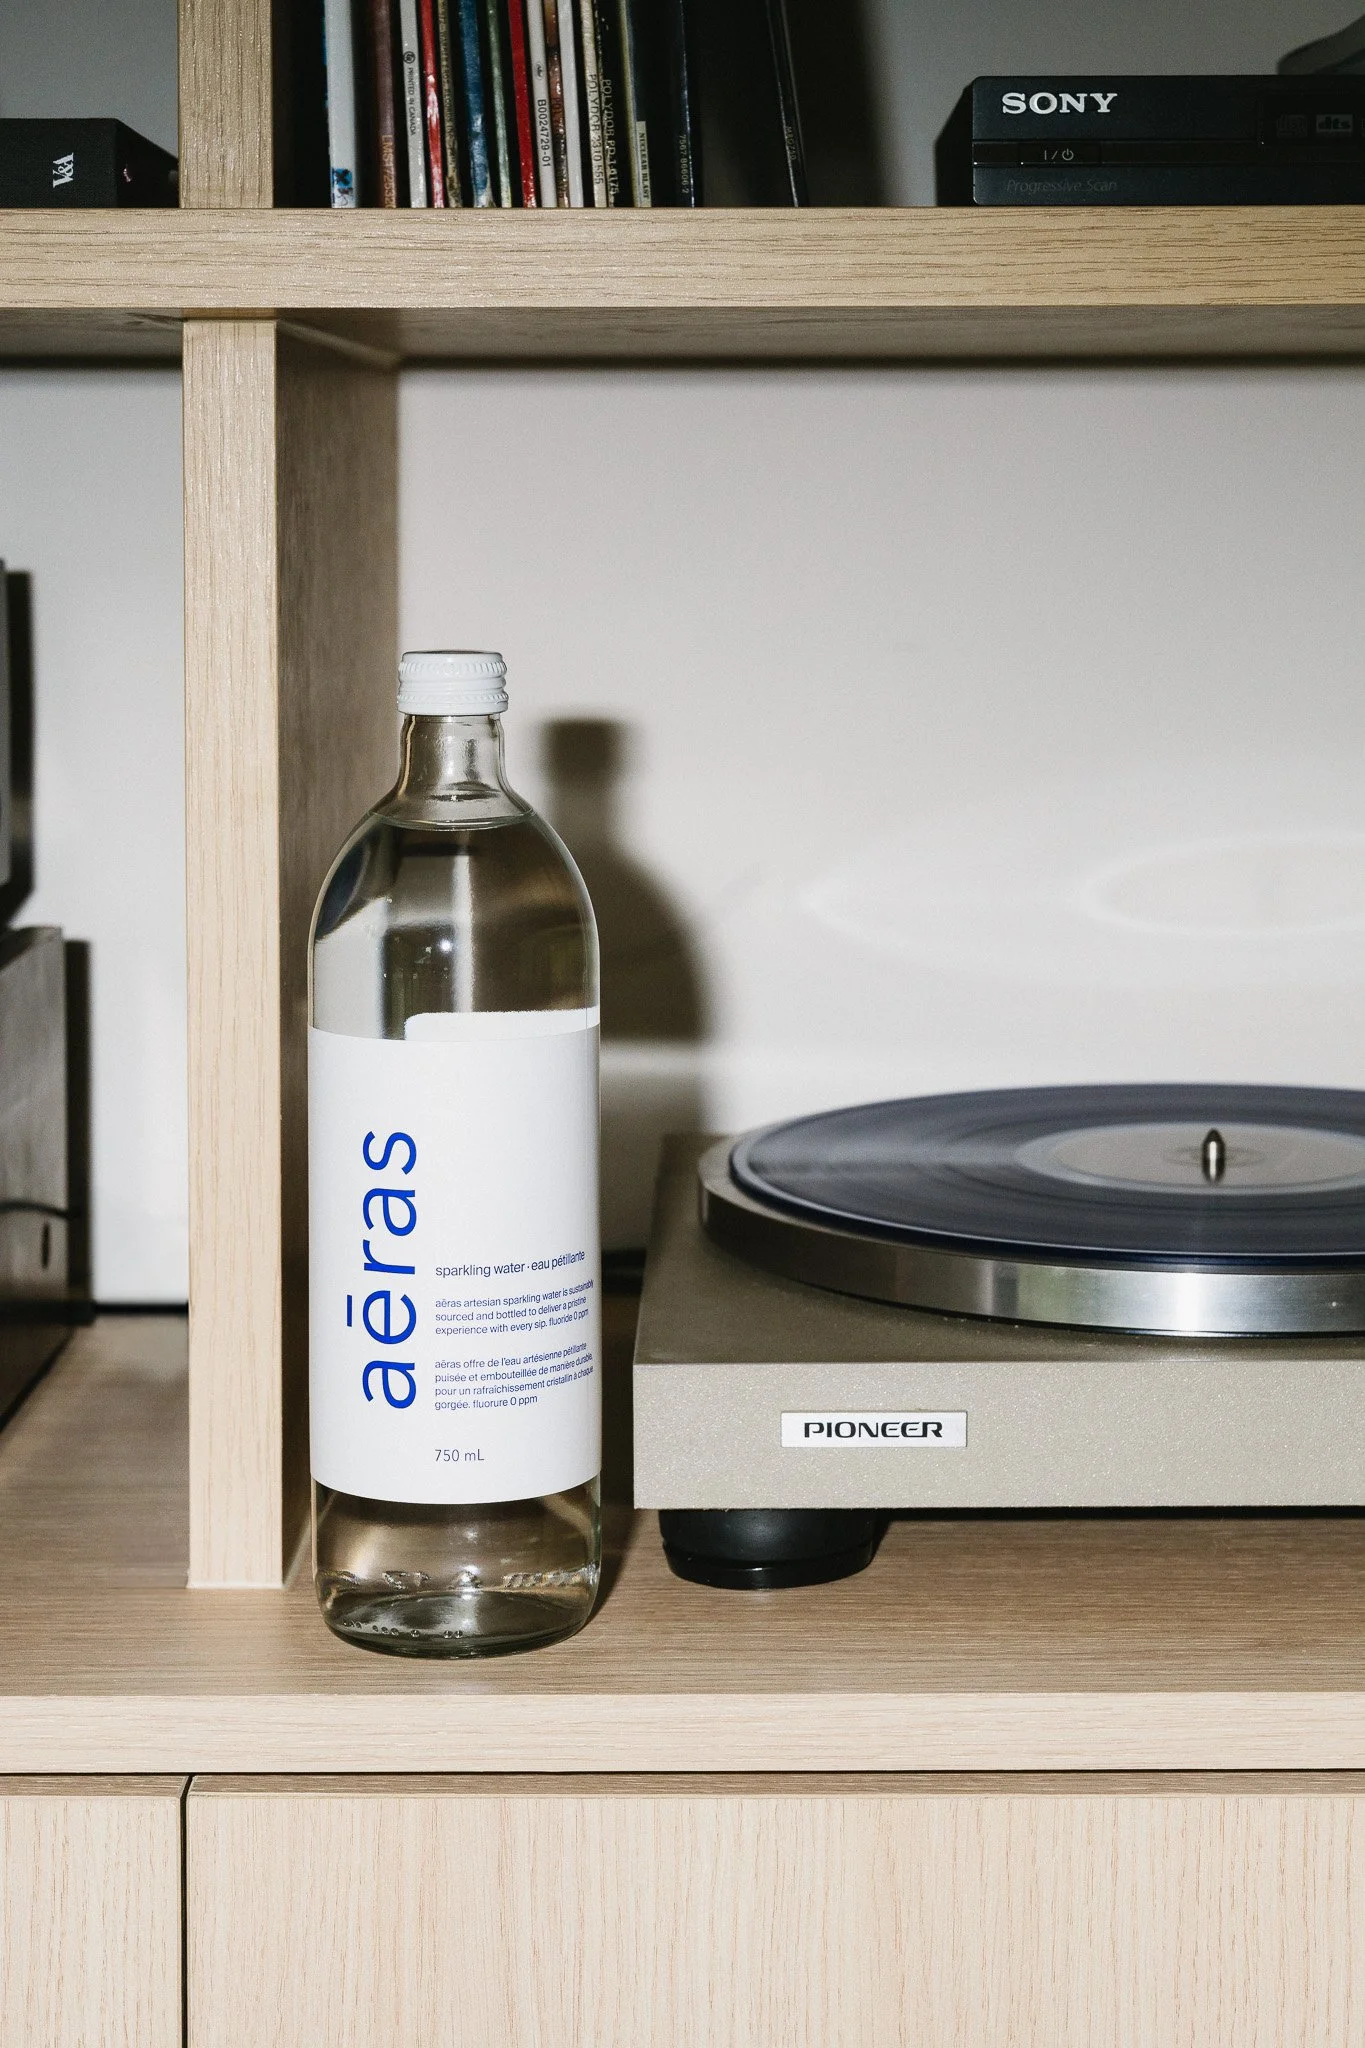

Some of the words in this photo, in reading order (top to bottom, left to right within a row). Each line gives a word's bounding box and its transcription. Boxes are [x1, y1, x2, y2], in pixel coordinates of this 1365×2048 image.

[406, 67, 415, 96] PRINTED
[409, 97, 415, 105] IN
[588, 74, 602, 132] POLYDOR
[602, 79, 615, 136] POLYDOR
[1001, 92, 1118, 115] SONY
[408, 106, 417, 136] CANADA
[537, 99, 551, 168] B0024729-01
[638, 132, 648, 171] NUCLEAR
[52, 152, 75, 189] V&A
[641, 173, 650, 200] BLAST
[1006, 178, 1083, 193] Progressive
[1086, 178, 1118, 192] Scan
[347, 1131, 417, 1410] aēras
[435, 1264, 491, 1278] sparkling
[493, 1262, 526, 1275] water
[531, 1260, 550, 1271] eau
[551, 1251, 585, 1270] pétillante
[435, 1312, 474, 1321] sourced
[476, 1311, 494, 1321] and
[496, 1308, 527, 1319] bottled
[528, 1307, 537, 1316] to
[538, 1304, 562, 1315] deliver
[562, 1302, 567, 1310] a
[567, 1296, 587, 1310] pristine
[463, 1298, 501, 1307] artesian
[503, 1294, 541, 1306] sparkling
[542, 1290, 561, 1300] water
[562, 1288, 568, 1297] is
[435, 1326, 488, 1336] experience
[489, 1323, 509, 1333] with
[510, 1322, 533, 1332] every
[534, 1319, 548, 1330] sip.
[549, 1313, 573, 1326] fluoride
[573, 1310, 578, 1320] 0
[578, 1308, 589, 1319] ppm
[463, 1359, 486, 1369] offre
[487, 1358, 499, 1368] de
[522, 1350, 562, 1364] artésienne
[563, 1342, 587, 1358] pétillante
[435, 1373, 467, 1383] puisée
[468, 1373, 478, 1382] et
[480, 1368, 537, 1381] embouteillée
[538, 1366, 549, 1376] de
[549, 1361, 575, 1373] manière
[435, 1388, 457, 1397] pour
[459, 1388, 471, 1396] un
[473, 1380, 545, 1396] rafraîchissement
[546, 1374, 573, 1387] cristallin
[573, 1372, 578, 1380] à
[577, 1365, 594, 1379] chaque
[434, 1401, 471, 1411] gorgée.
[472, 1399, 509, 1408] fluorure
[509, 1396, 518, 1406] 0
[518, 1395, 538, 1407] ppm
[803, 1421, 944, 1439] PIONEER
[434, 1448, 460, 1462] 750
[464, 1448, 485, 1462] mL
